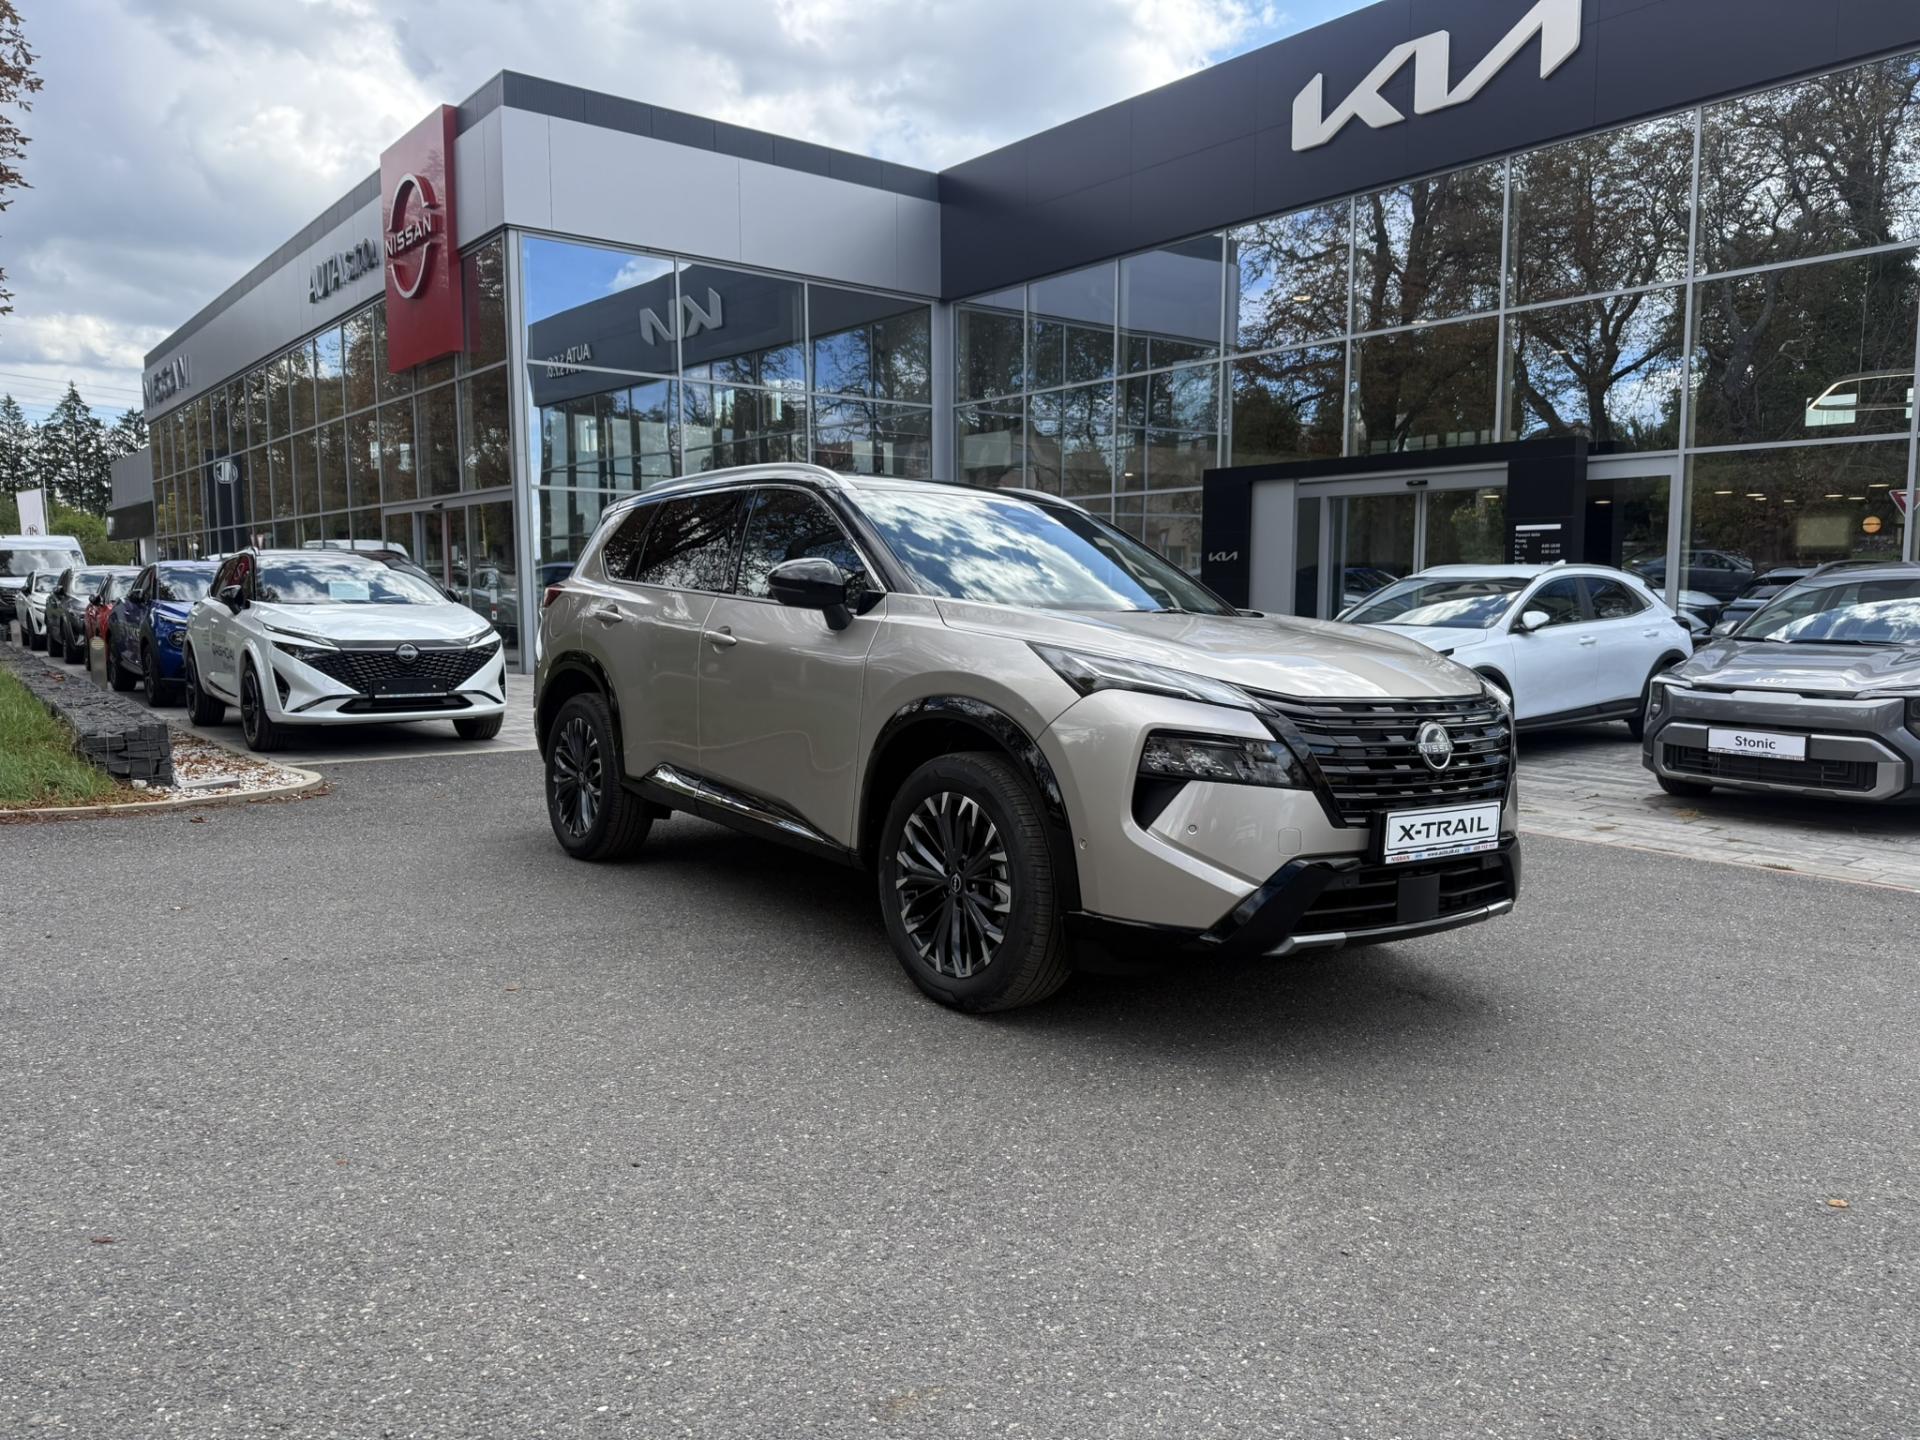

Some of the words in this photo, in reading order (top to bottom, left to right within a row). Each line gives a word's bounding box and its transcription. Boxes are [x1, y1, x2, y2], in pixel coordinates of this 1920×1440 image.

[1291, 0, 1582, 152] KIA
[385, 213, 432, 256] NISSAN
[1208, 551, 1238, 561] KIA
[1735, 735, 1776, 749] Stonic
[1398, 816, 1489, 842] X-TRAIL
